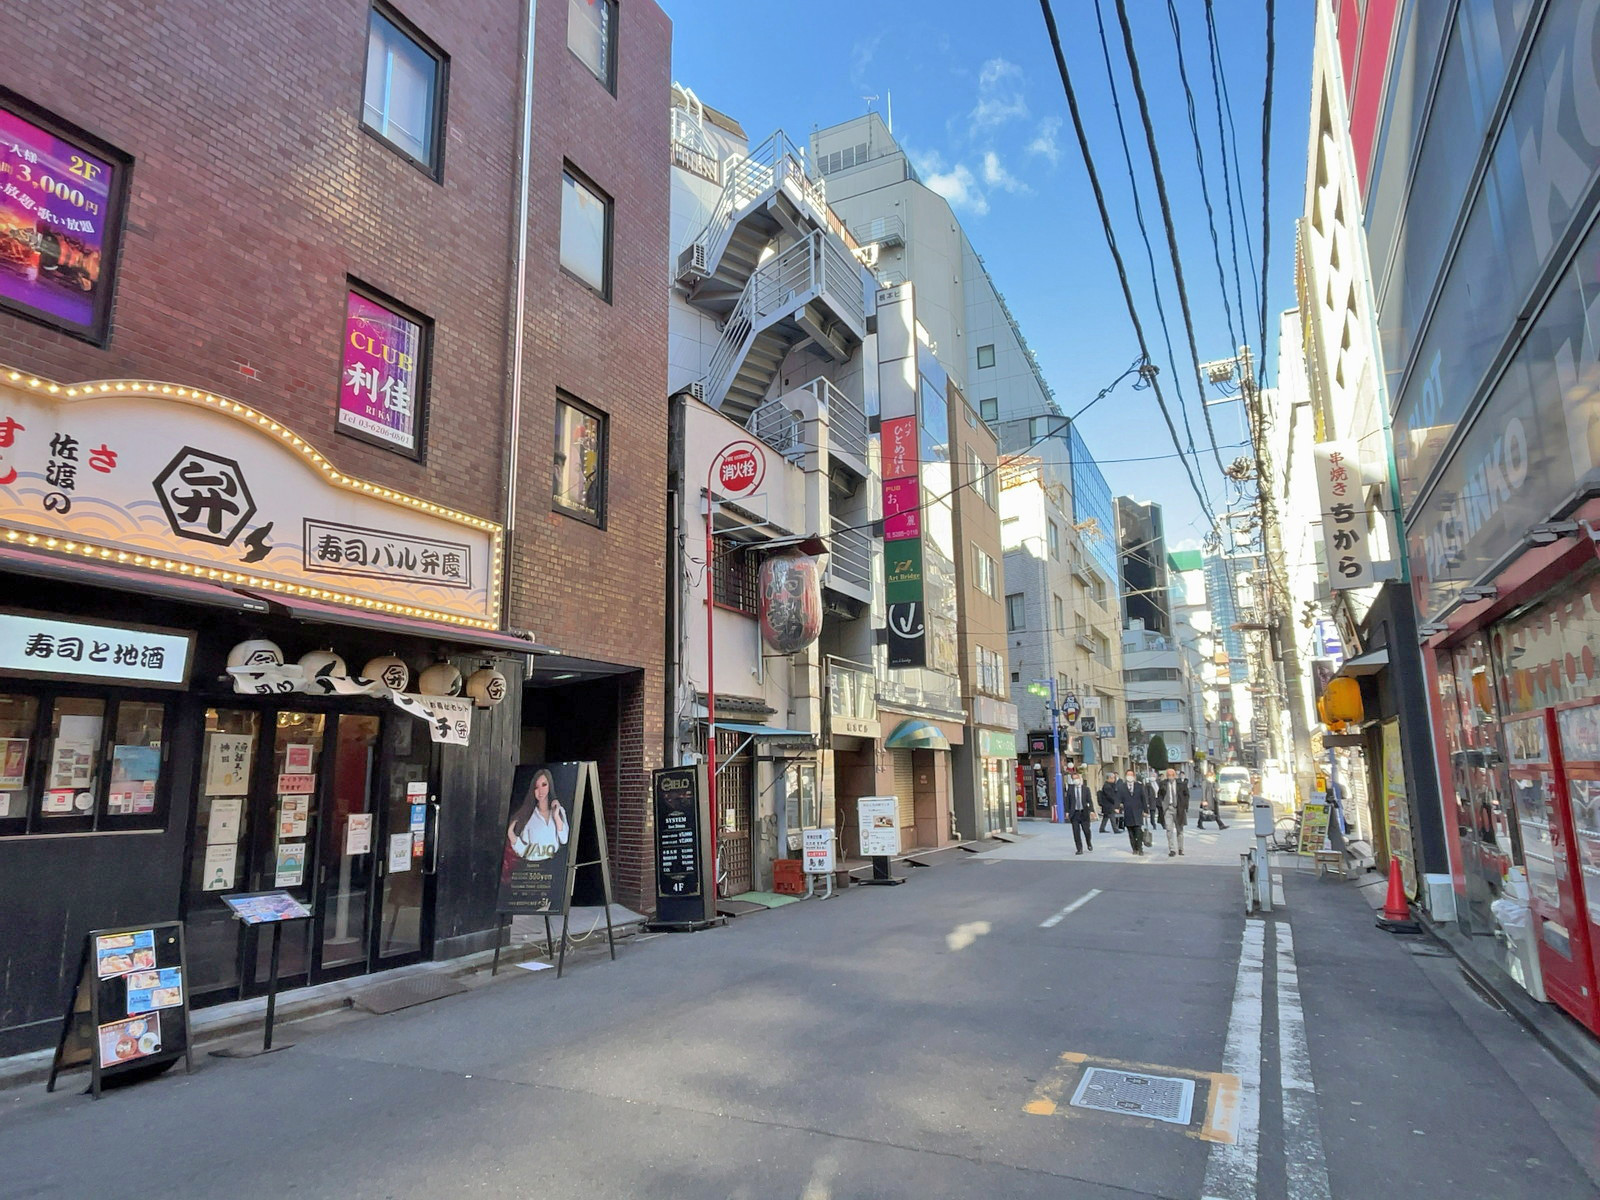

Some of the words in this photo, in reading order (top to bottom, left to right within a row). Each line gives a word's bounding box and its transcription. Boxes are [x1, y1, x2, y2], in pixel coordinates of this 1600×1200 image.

[69, 155, 102, 182] 2F
[350, 330, 413, 372] CLUB
[345, 361, 411, 417] 利佳
[42, 432, 80, 515] 佐渡の
[722, 459, 755, 482] 消火栓
[1329, 451, 1348, 496] 串焼き
[1424, 417, 1528, 584] PACHINKO
[317, 533, 462, 579] 寿司バル弁慶
[1330, 502, 1362, 578] ちから
[24, 632, 166, 670] 寿司と地酒
[672, 882, 685, 893] 4F
